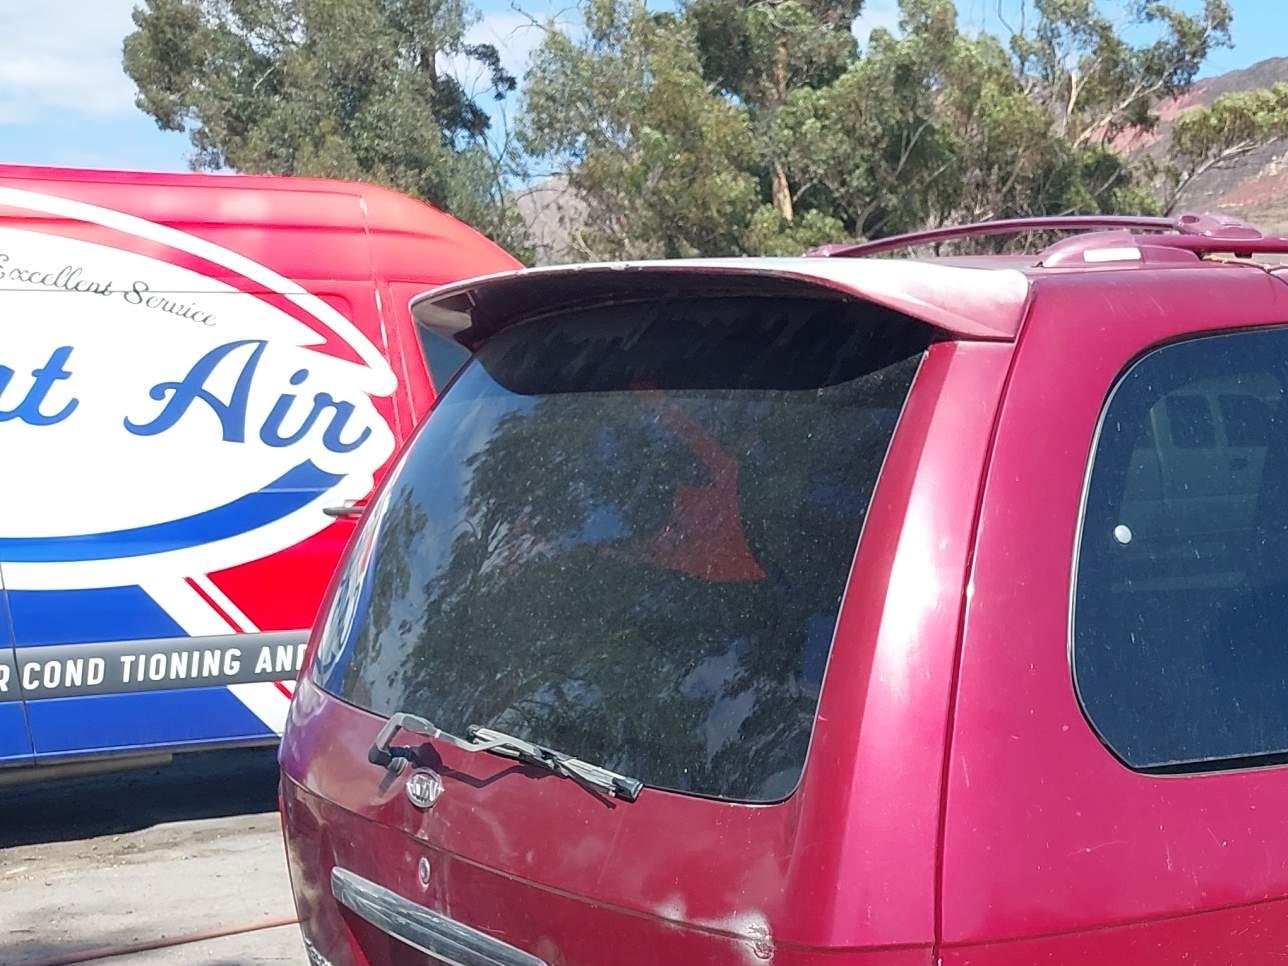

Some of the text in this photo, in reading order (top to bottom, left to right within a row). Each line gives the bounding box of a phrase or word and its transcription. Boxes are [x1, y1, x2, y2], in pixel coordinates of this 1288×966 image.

[123, 280, 217, 327] Service
[123, 339, 372, 453] Air
[22, 657, 105, 690] COND
[120, 648, 242, 683] TIONING
